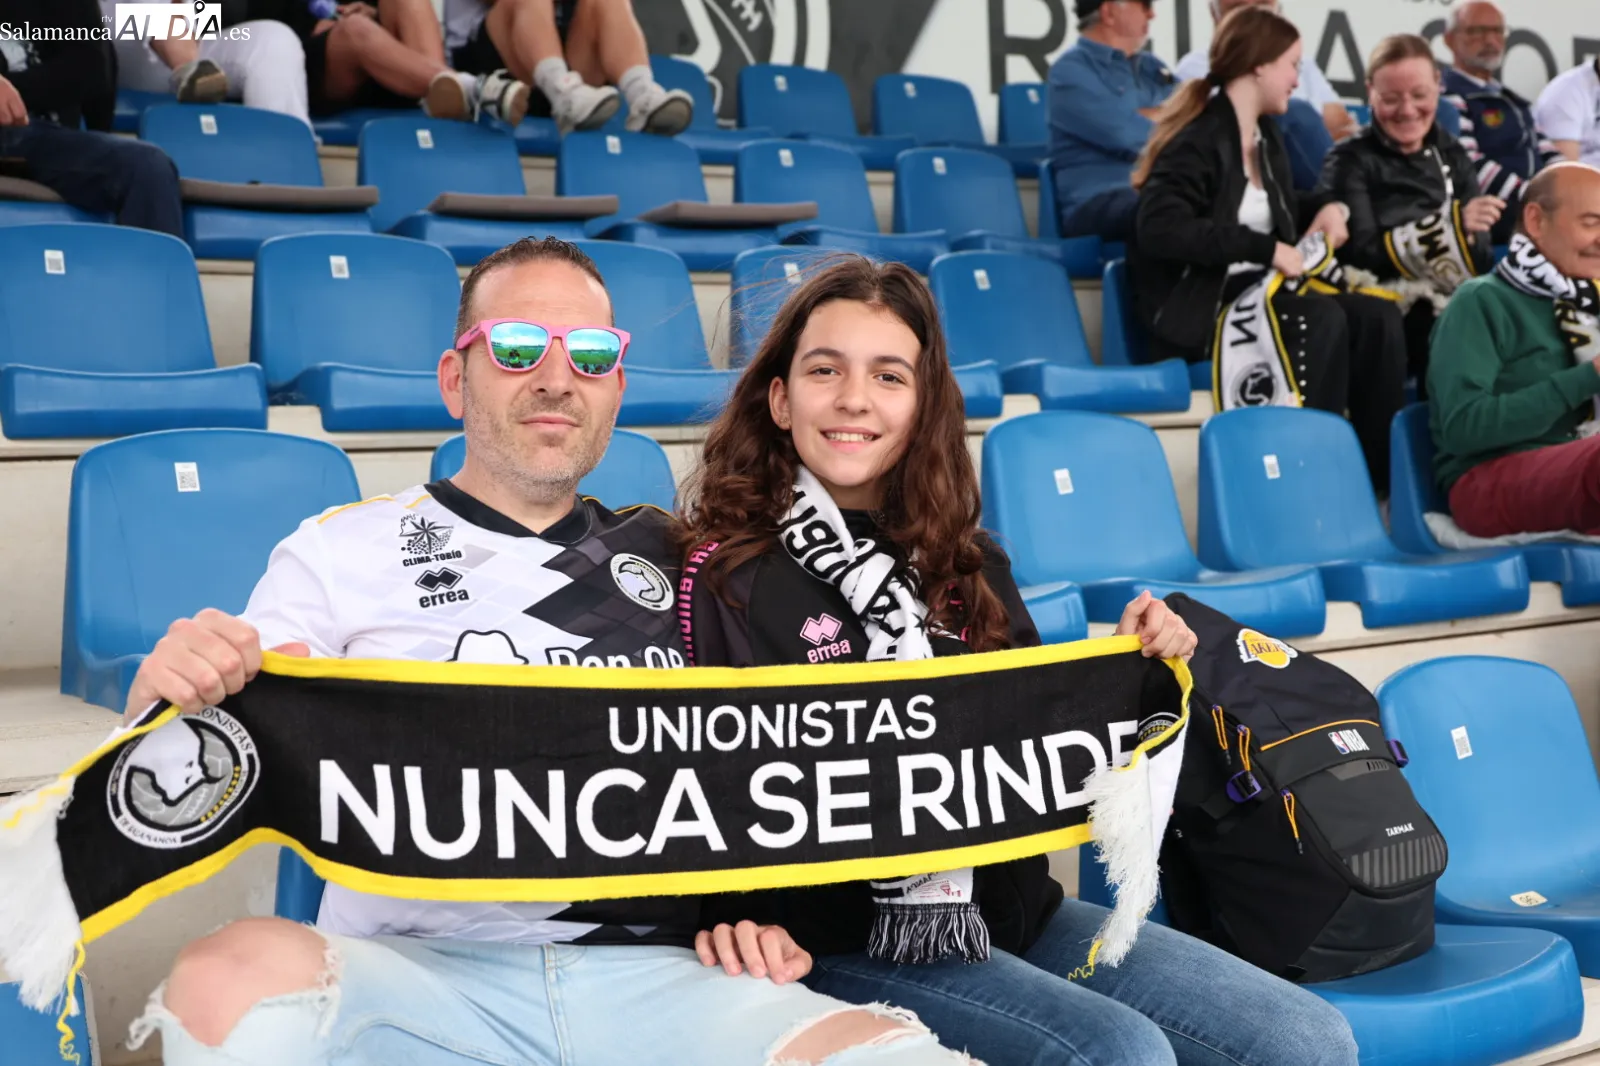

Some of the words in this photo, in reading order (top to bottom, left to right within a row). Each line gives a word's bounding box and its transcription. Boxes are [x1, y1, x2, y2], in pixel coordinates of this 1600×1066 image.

[608, 694, 937, 754] UNIONISTAS
[1338, 728, 1370, 753] NBA
[319, 758, 728, 861] NUNCA
[747, 758, 873, 849] SE
[1385, 822, 1415, 837] TARMAK
